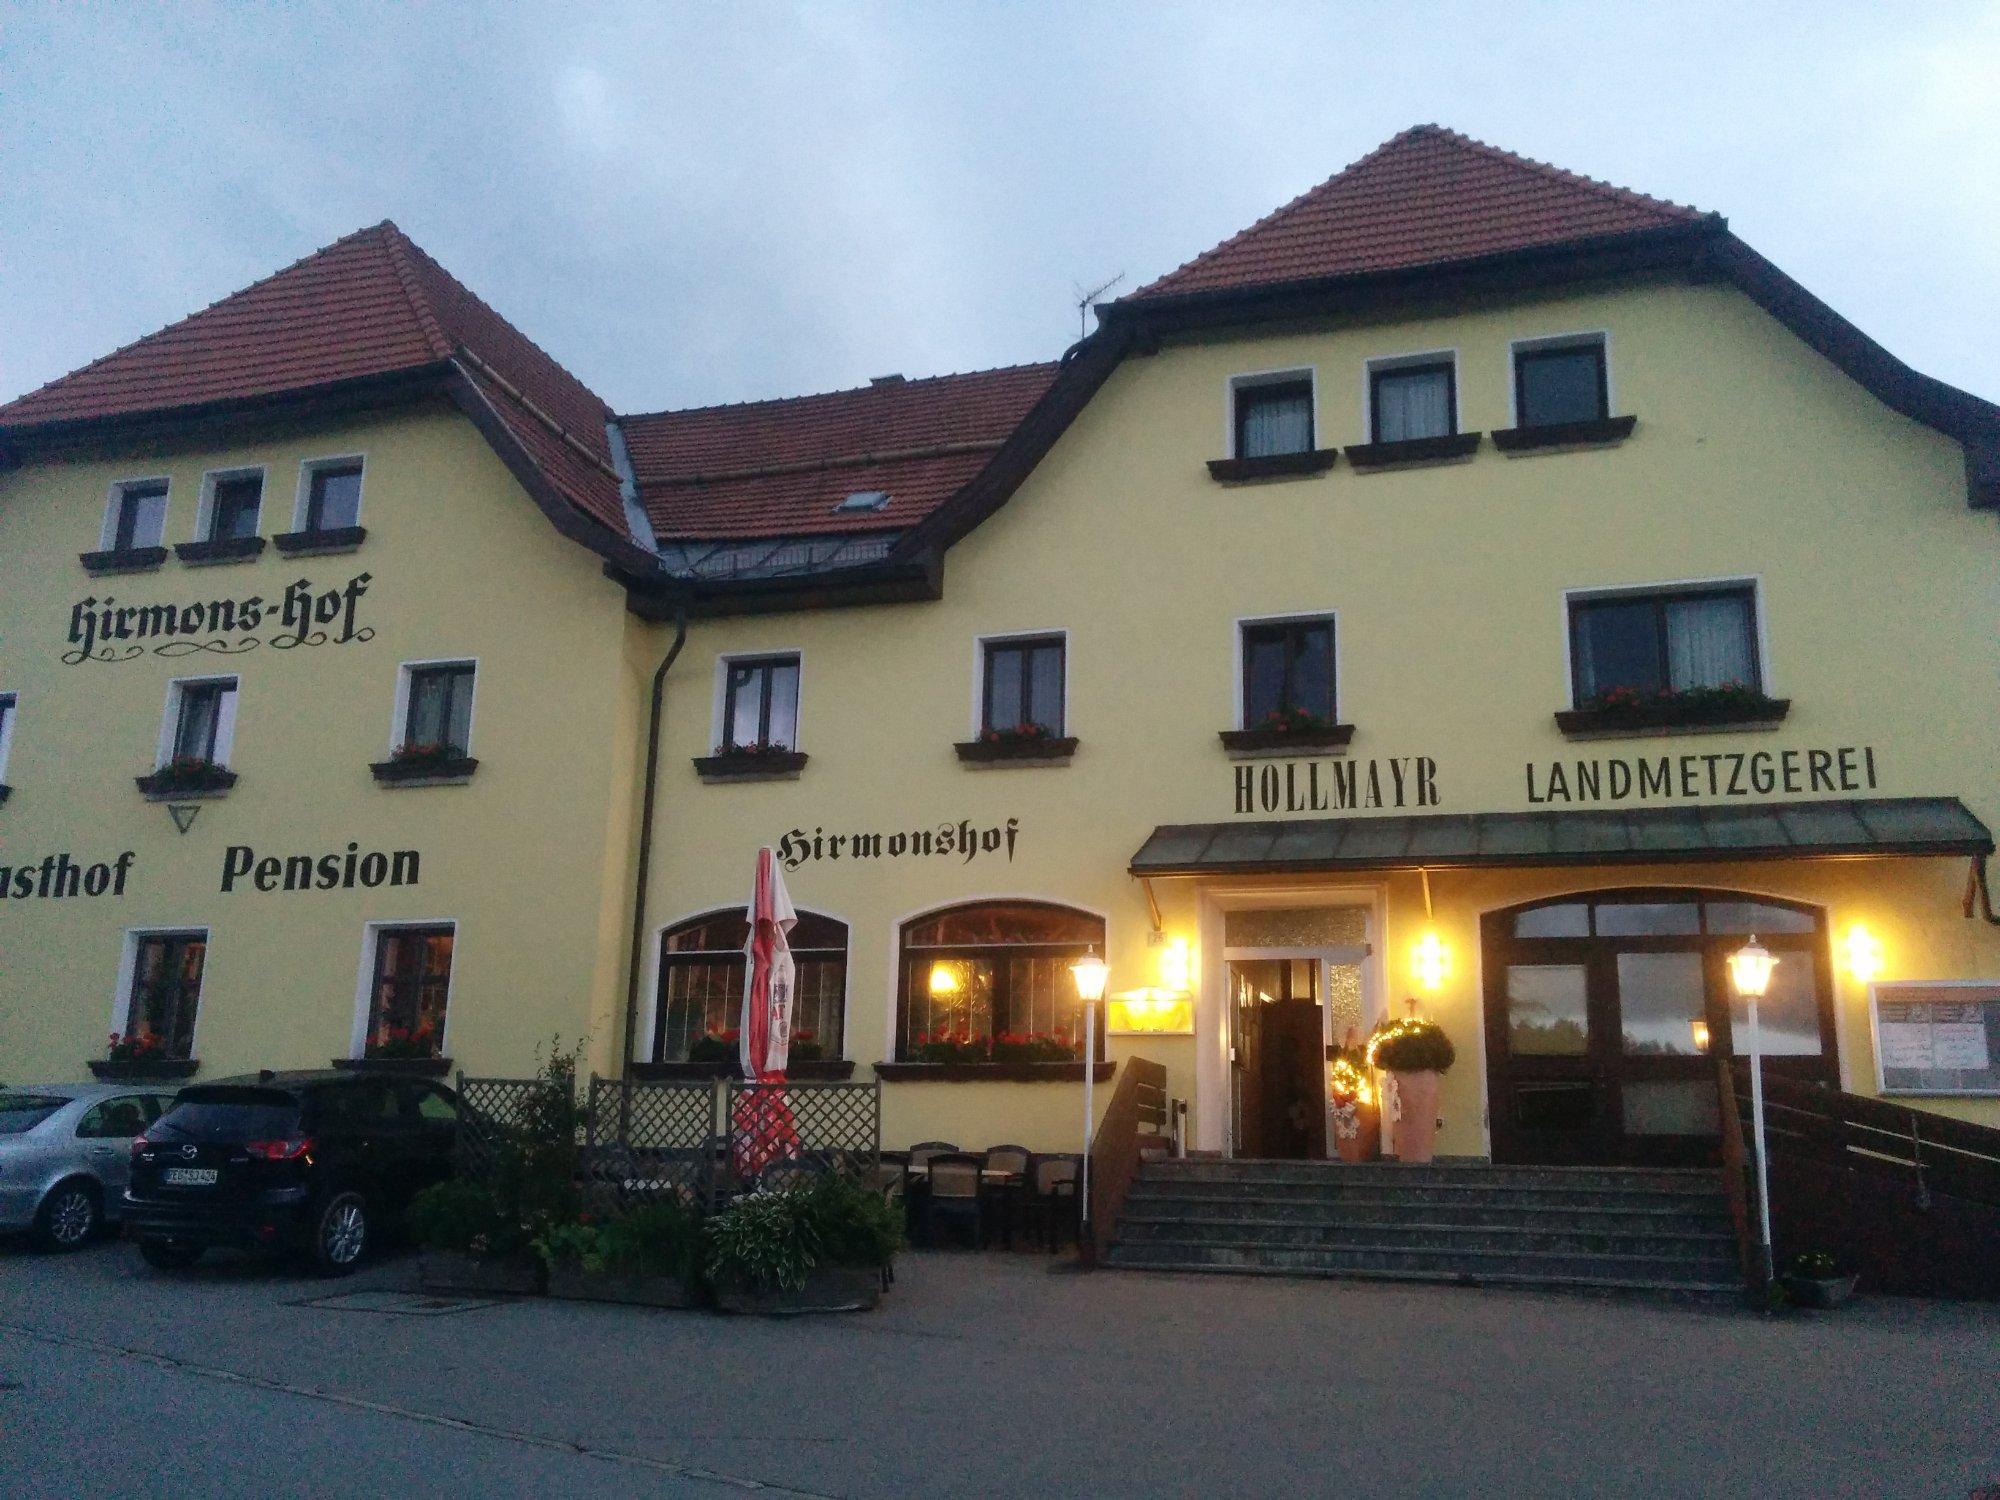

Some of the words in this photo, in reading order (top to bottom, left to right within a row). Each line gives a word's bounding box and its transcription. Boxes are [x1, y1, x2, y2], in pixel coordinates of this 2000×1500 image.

[1234, 756, 1441, 813] HOLLMAYR
[1526, 746, 1877, 803] LANDMETZGEREI
[220, 842, 419, 892] Pension
[776, 817, 1019, 872] Hirmonshof
